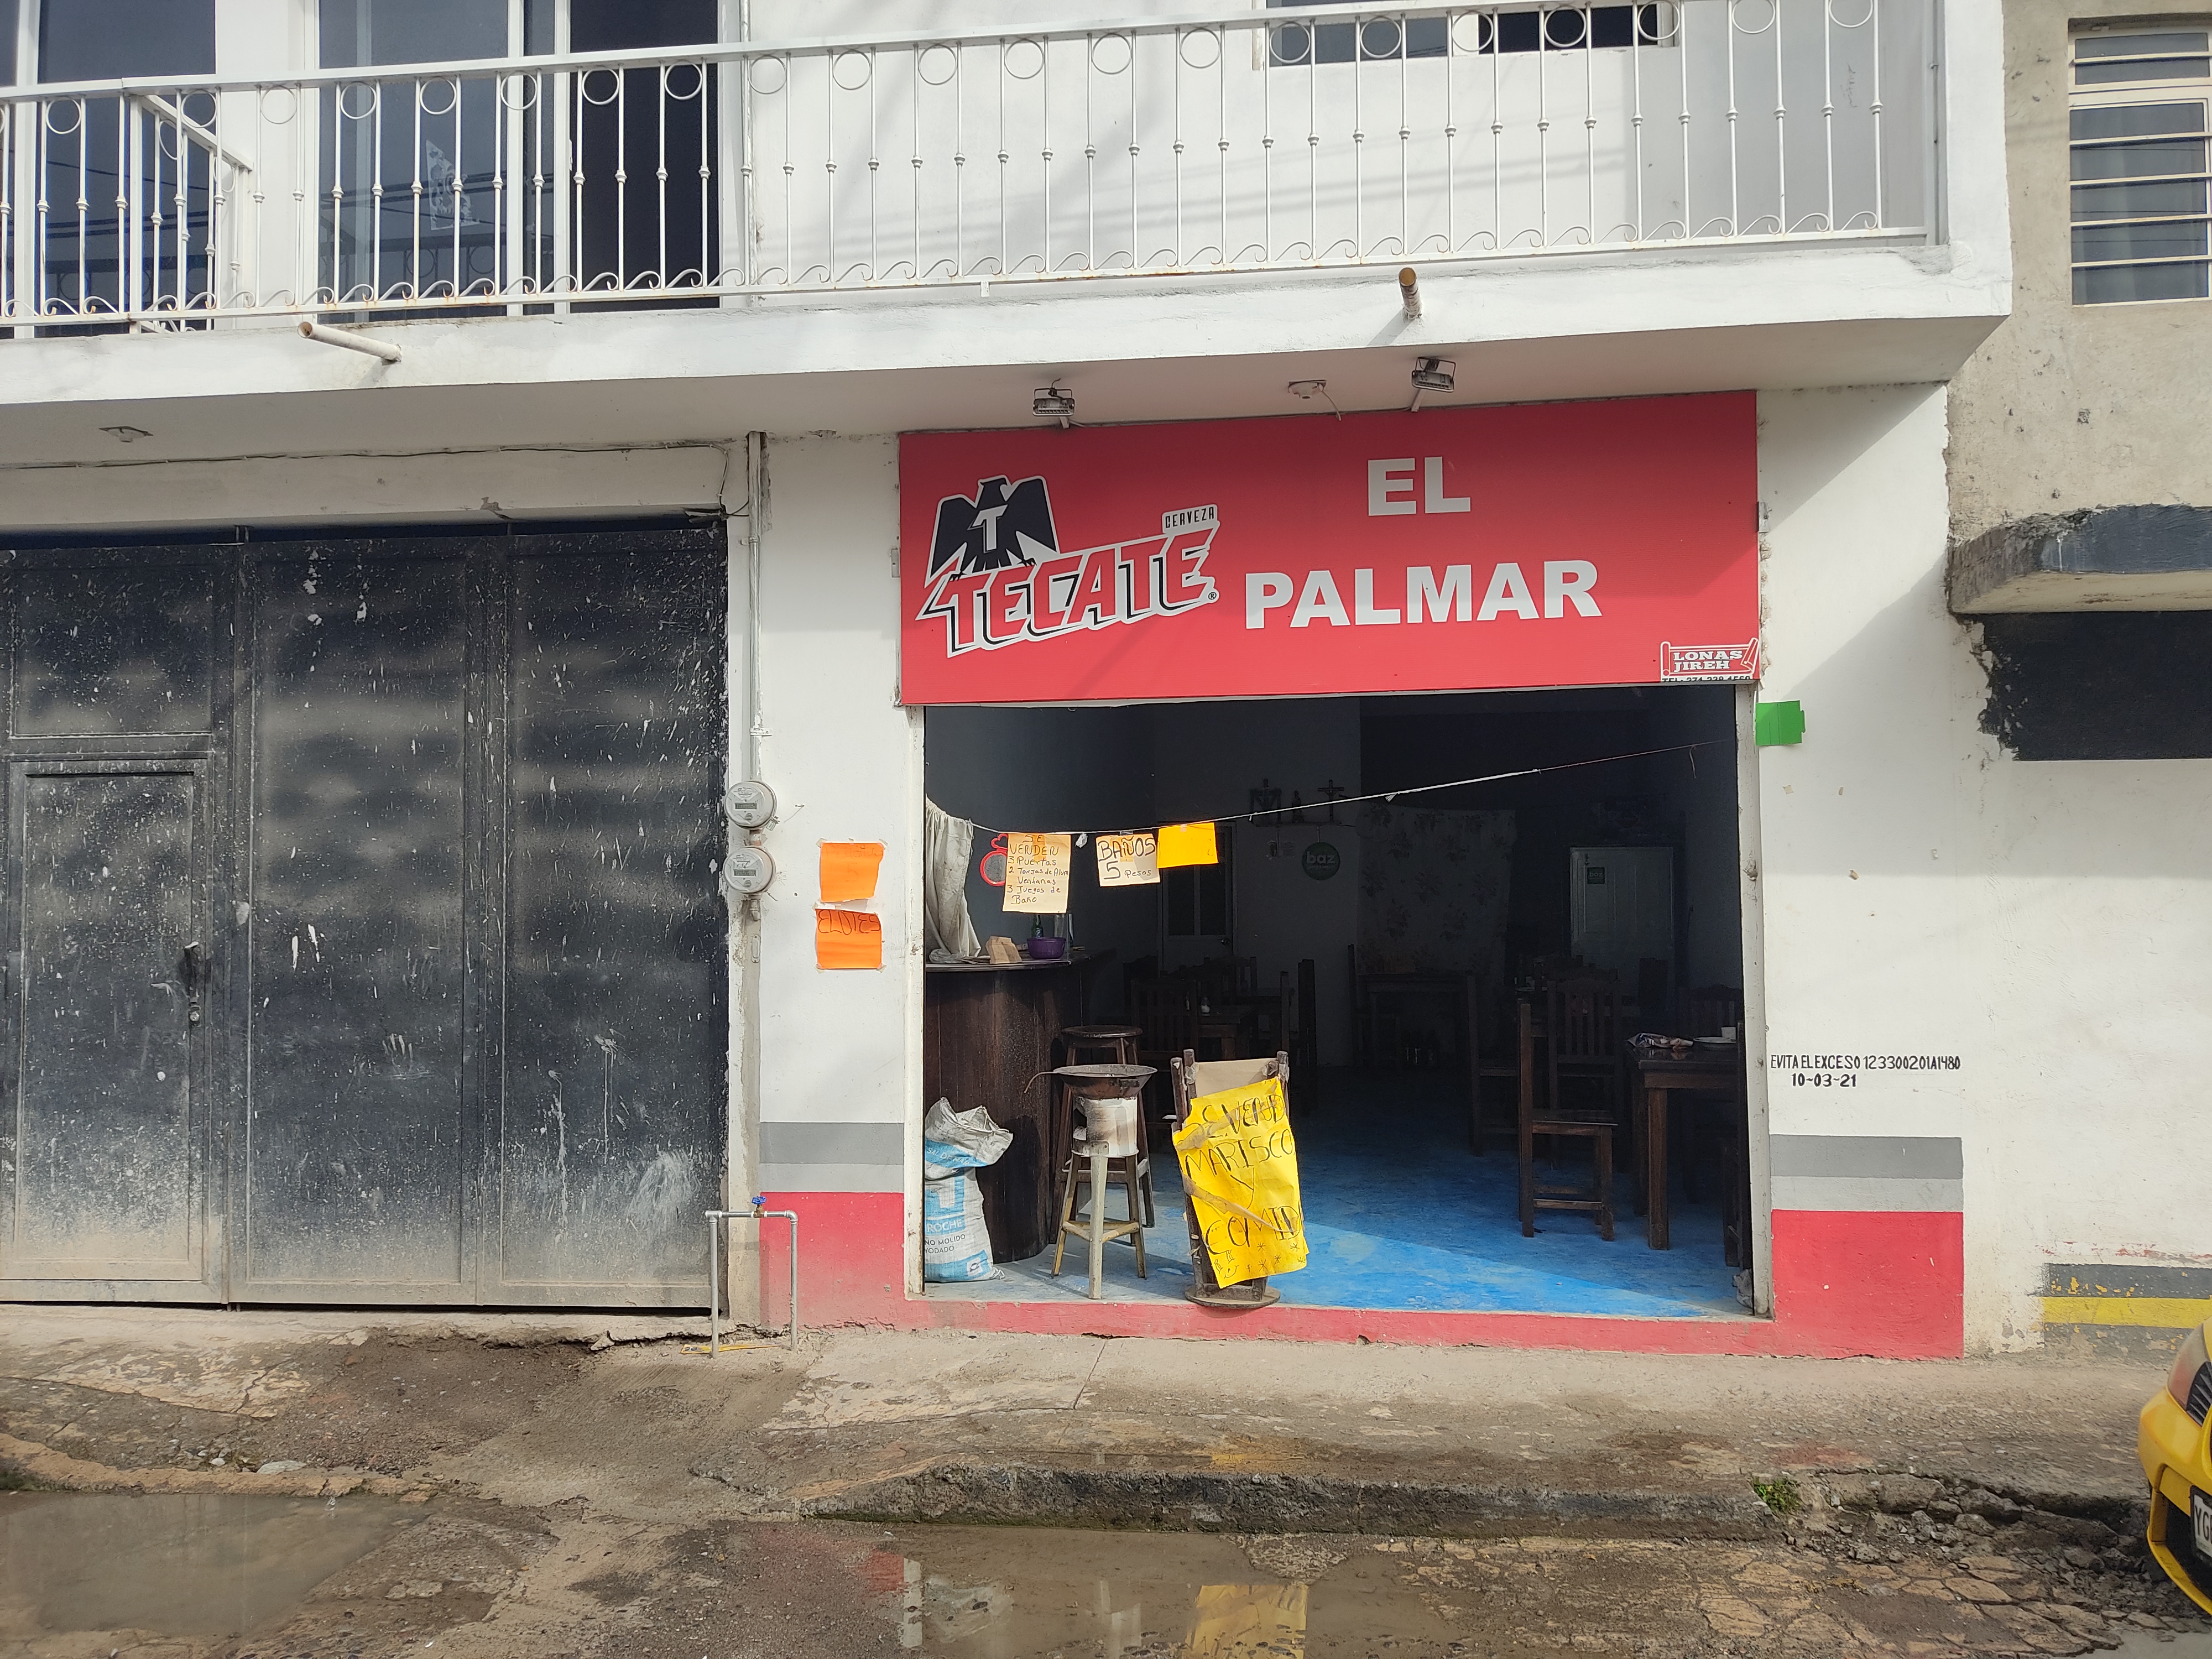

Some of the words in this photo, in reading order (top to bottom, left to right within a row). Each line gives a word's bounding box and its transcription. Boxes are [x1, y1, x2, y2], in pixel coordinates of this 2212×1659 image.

[1368, 456, 1471, 516] EL
[1165, 506, 1215, 529] CERVEZA
[916, 524, 1218, 657] TECATE
[1245, 559, 1603, 629] PALMAR
[1673, 650, 1743, 661] LONAS
[1673, 660, 1730, 673] JIREH
[1022, 834, 1045, 843] SE
[1009, 843, 1059, 857] VENDEN
[1098, 836, 1156, 862] BAÑOS
[1016, 855, 1056, 867] Puertas
[1306, 851, 1335, 864] baz
[1103, 860, 1121, 880] 5
[1018, 876, 1056, 885] Ventanas
[1007, 885, 1013, 893] 3
[1016, 885, 1045, 894] Juegos
[1771, 1055, 1799, 1069] EVITA
[1801, 1055, 1814, 1069] EL
[1814, 1055, 1861, 1070] EXCESO
[1791, 1073, 1856, 1088] 10-03-21
[927, 1147, 939, 1156] SAL
[926, 1219, 963, 1233] ROCHE
[938, 1234, 966, 1246] MOLIDO
